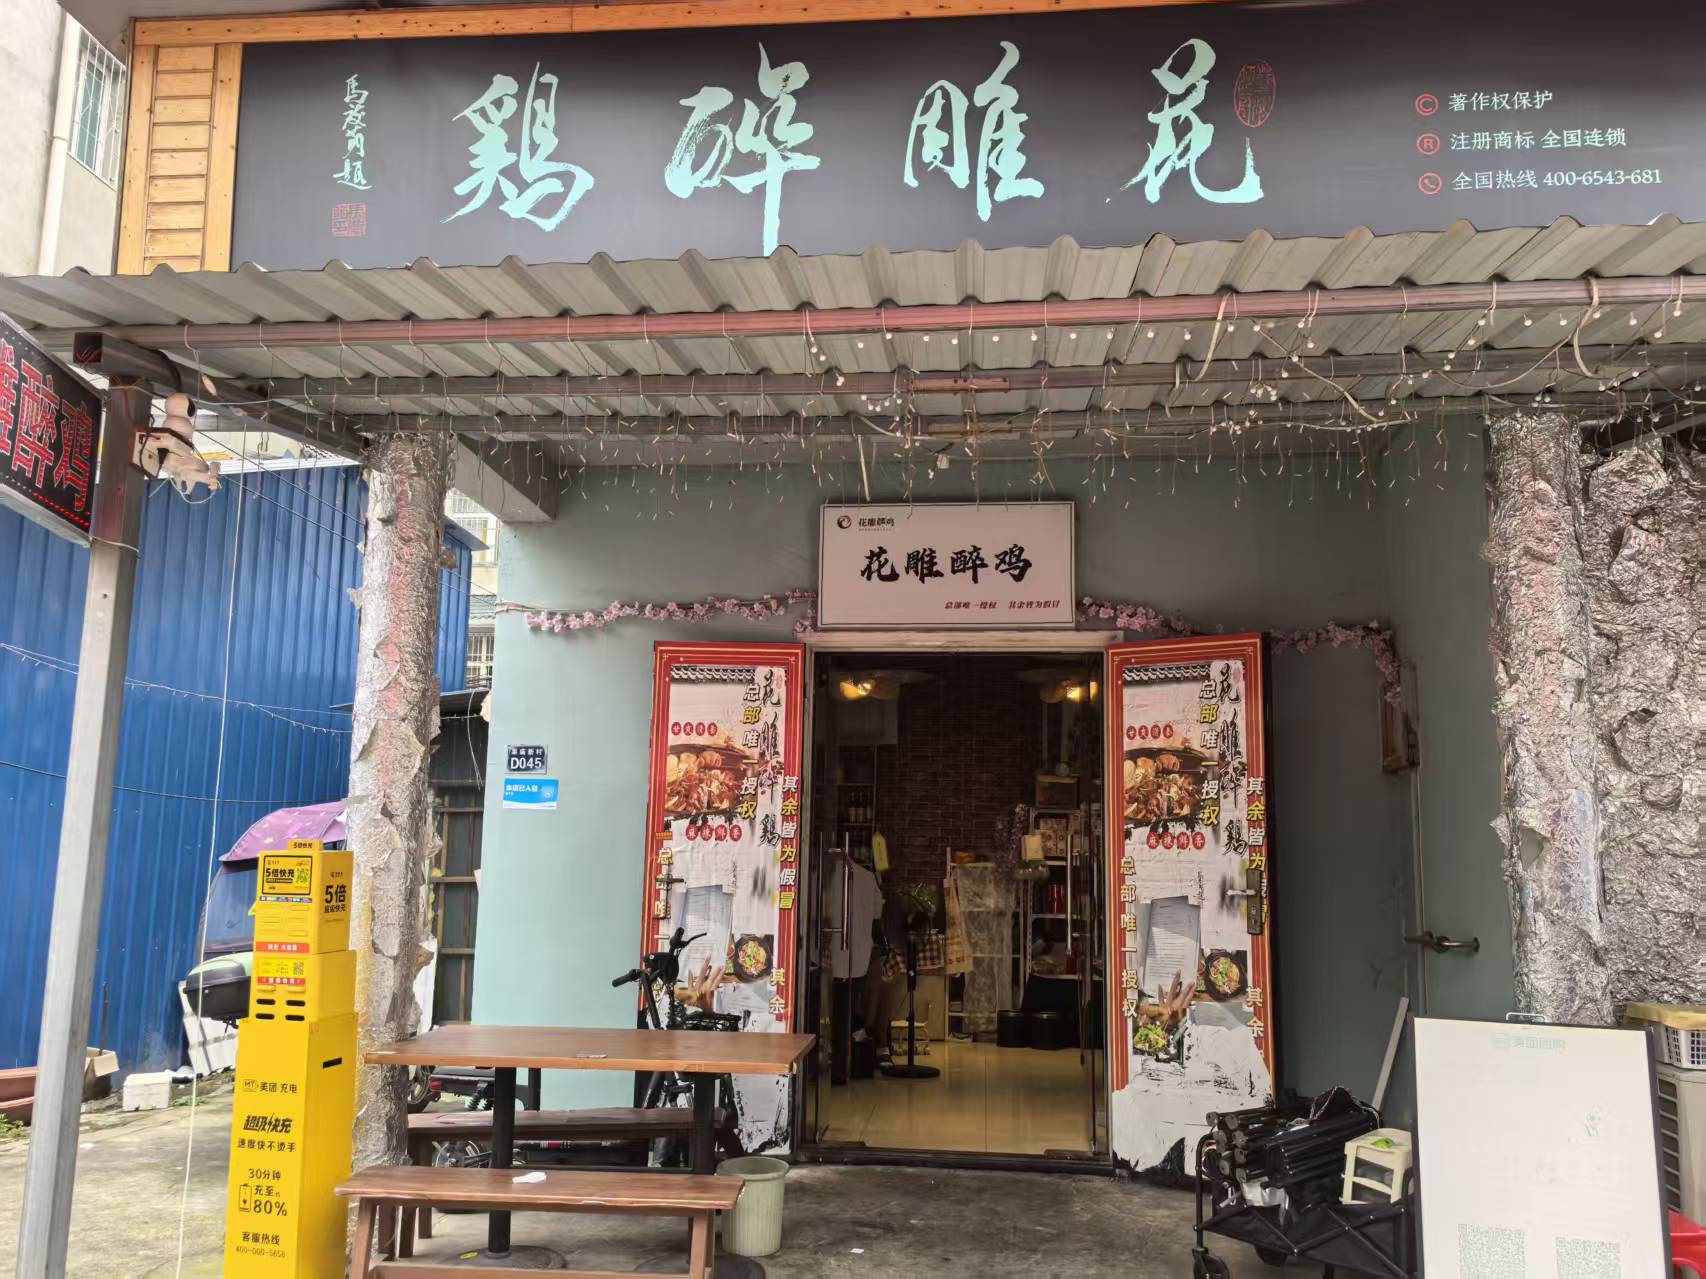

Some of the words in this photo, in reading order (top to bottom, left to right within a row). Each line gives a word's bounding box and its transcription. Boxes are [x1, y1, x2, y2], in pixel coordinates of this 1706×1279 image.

[1448, 90, 1553, 112] 著作权保护
[1449, 130, 1535, 151] 注册商标
[1540, 127, 1627, 149] 全国连锁
[1452, 169, 1538, 190] 全国热线
[1543, 169, 1662, 187] 400-6543-681
[860, 544, 1033, 584] 花雕醉鸡
[740, 683, 761, 820] 总部唯一授权
[1199, 679, 1219, 826] 总部唯一授权
[510, 757, 542, 769] D045
[779, 775, 799, 910] 其余皆为假冒
[265, 867, 295, 878] 5倍快充
[324, 884, 347, 904] 5倍
[1119, 856, 1138, 1018] 总部唯一授权
[768, 967, 785, 1014] 其余
[259, 1081, 277, 1093] 美团
[280, 1083, 298, 1094] 充电
[243, 1114, 293, 1134] 超级快充
[237, 1137, 296, 1153] 速度快不烫手
[248, 1168, 282, 1182] 30分钟
[253, 1199, 288, 1217] 80%
[241, 1231, 280, 1246] 客服热线
